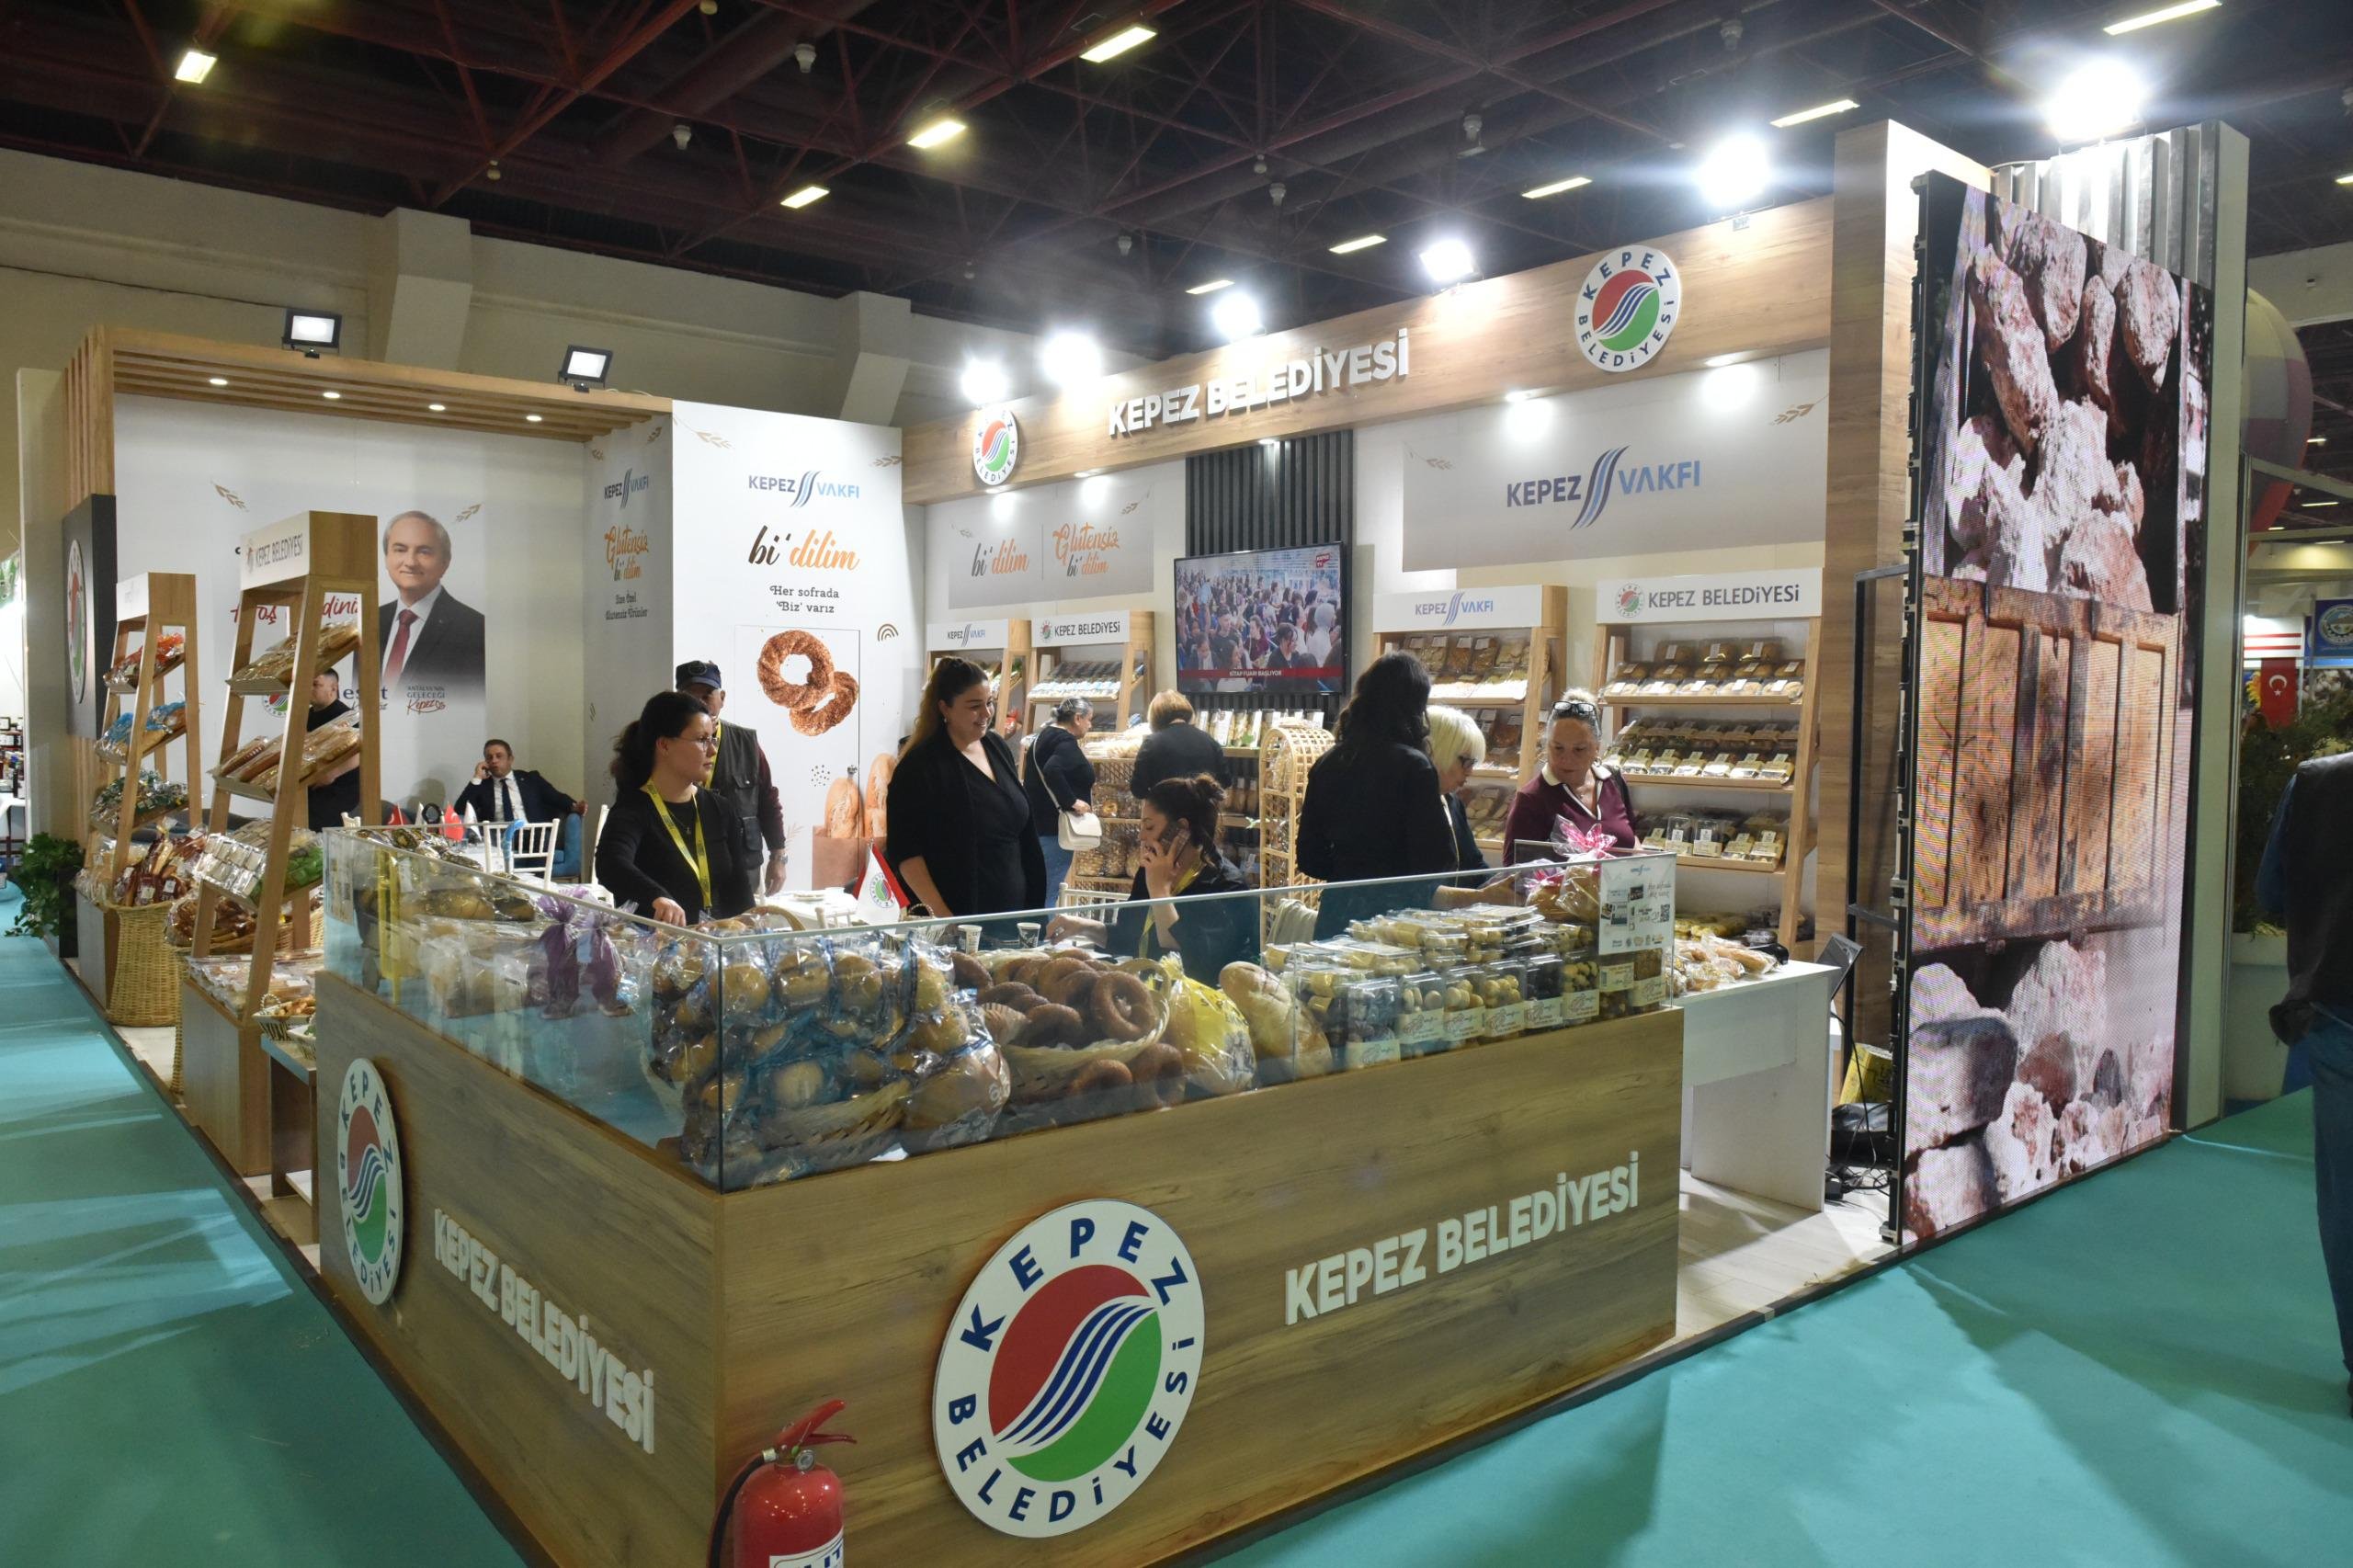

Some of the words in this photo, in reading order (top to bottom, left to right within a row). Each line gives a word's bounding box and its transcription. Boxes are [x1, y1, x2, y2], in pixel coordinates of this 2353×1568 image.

[1583, 251, 1671, 301] KEPEZ
[1108, 384, 1200, 437] KEPEZ
[1207, 328, 1410, 415] BELEDİYESİ
[604, 483, 622, 499] KEPEZ
[749, 474, 796, 493] KEPEZ
[817, 482, 860, 499] VAKFI
[1507, 475, 1582, 507] KEPEZ
[1619, 460, 1700, 495] VAKFI
[790, 528, 860, 571] dilim
[992, 538, 1030, 574] dilim
[769, 585, 795, 597] Her
[798, 586, 840, 598] sofrada
[806, 603, 835, 614] varız
[1415, 603, 1447, 616] KEPEZ
[1461, 600, 1494, 613] VAKFI
[1649, 590, 1696, 608] KEPEZ
[947, 631, 963, 640] KEPEZ
[1054, 624, 1075, 637] KEPEZ
[342, 1069, 394, 1174] KEPEZ
[1285, 1227, 1427, 1325] KEPEZ
[1437, 1150, 1640, 1274] BELEDİYESİ
[960, 1217, 1188, 1353] KEPEZ
[434, 1208, 499, 1312] KEPEZ
[501, 1263, 654, 1455] BELEDİYESİ
